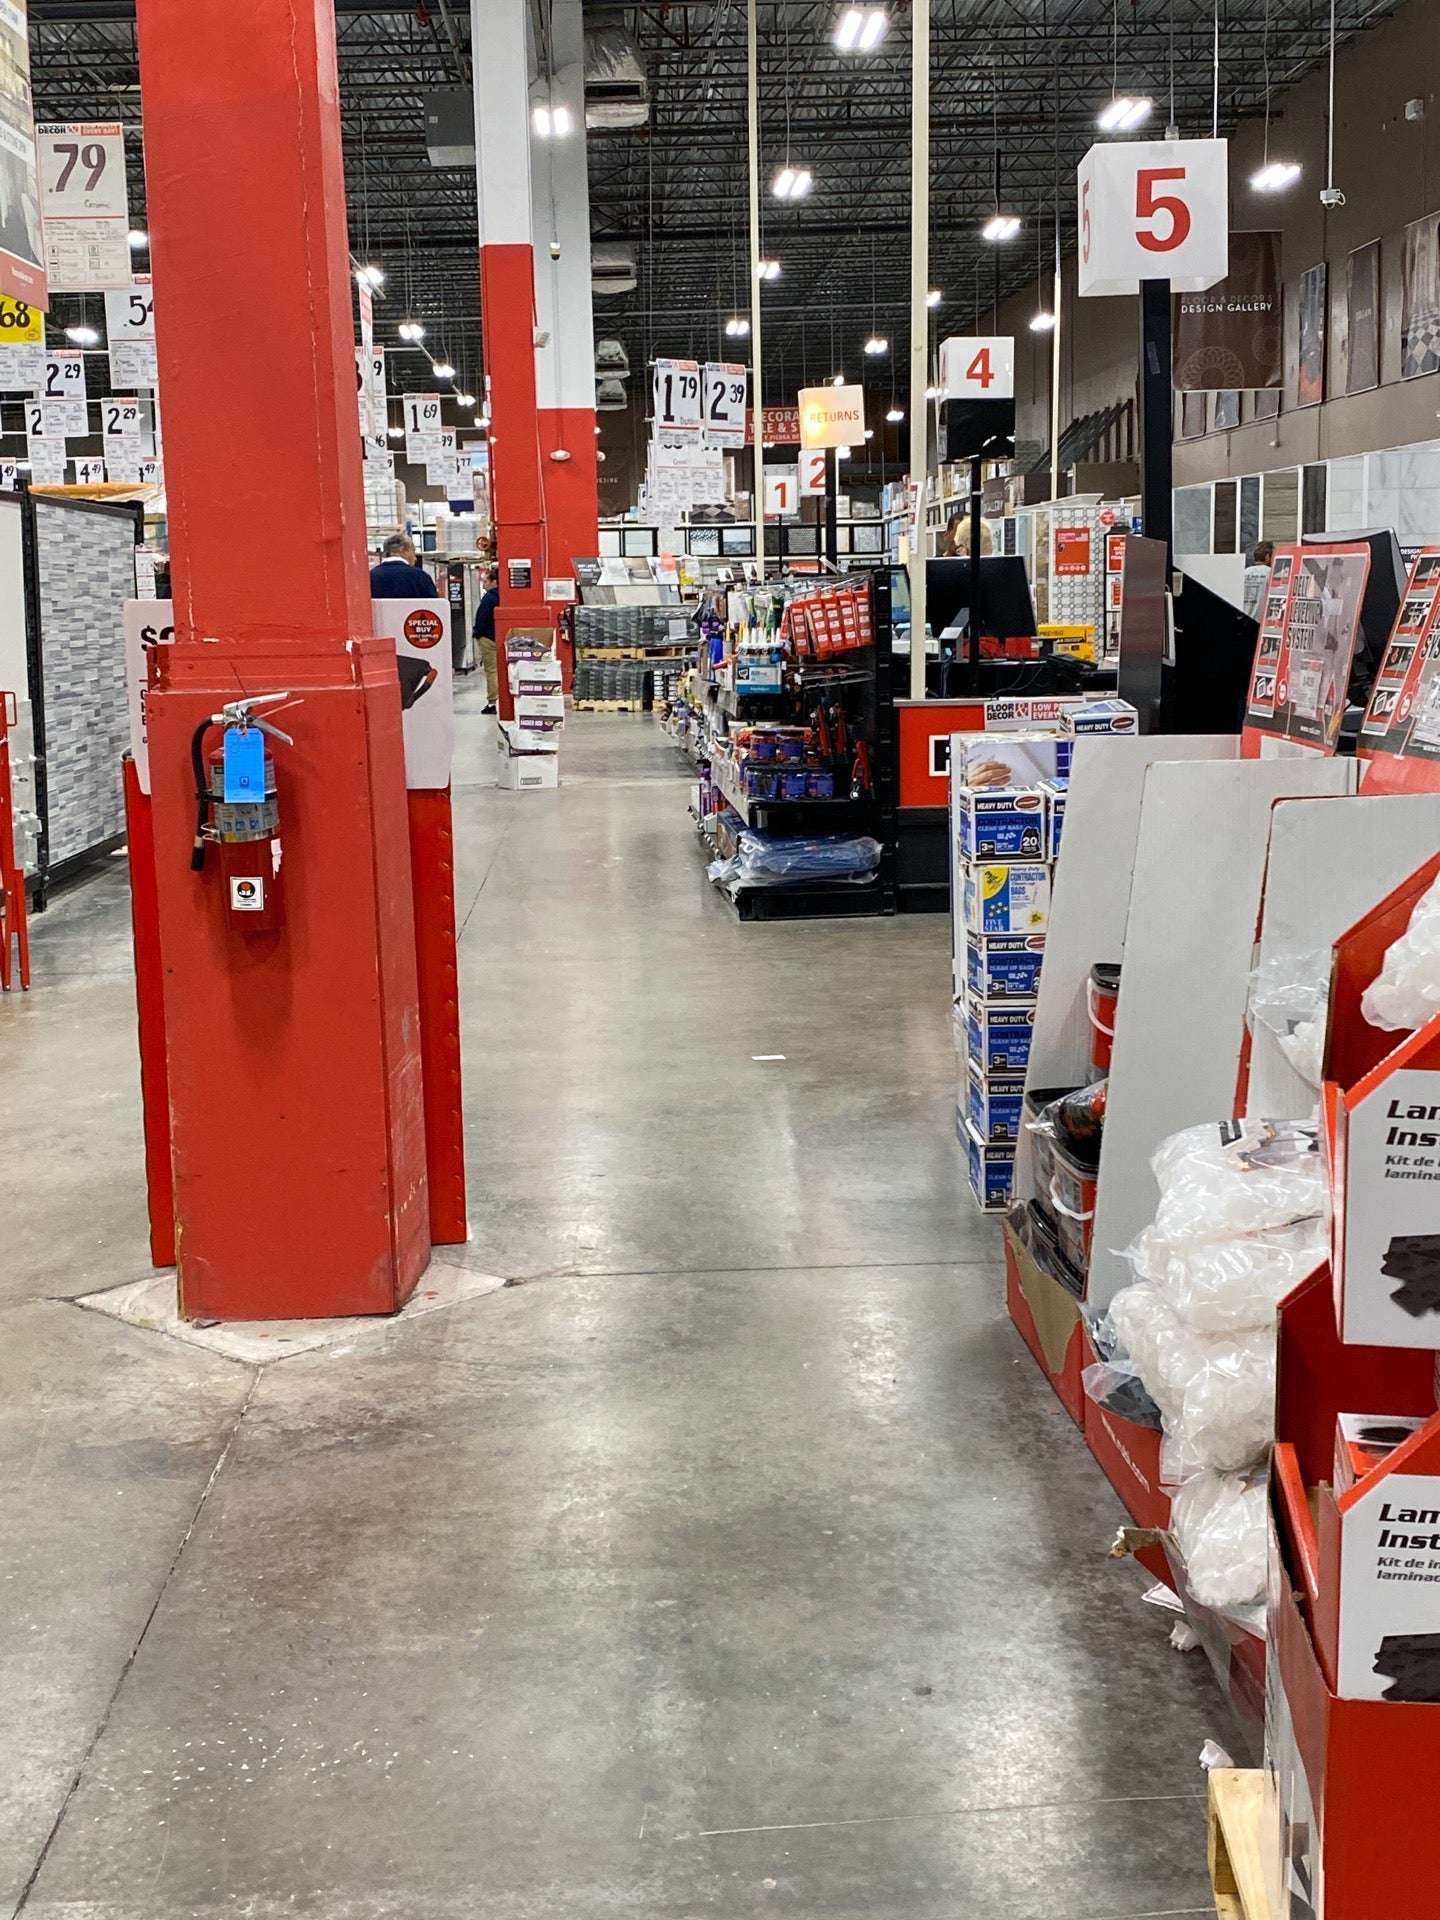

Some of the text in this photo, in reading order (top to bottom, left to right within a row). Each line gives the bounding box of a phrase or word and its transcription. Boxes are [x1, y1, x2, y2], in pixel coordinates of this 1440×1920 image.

[1135, 167, 1191, 253] 5
[1181, 302, 1273, 314] DESIGN GALLERY
[966, 348, 995, 389] 4
[809, 410, 860, 424] RETURNS
[749, 422, 774, 434] TLE
[777, 422, 787, 433] &
[809, 456, 826, 489] 2
[774, 482, 787, 509] 1
[408, 619, 439, 627] SPECIAL
[1286, 627, 1315, 651] SYSTEM
[986, 703, 1014, 712] FLOOR
[1032, 703, 1052, 712] LOW
[986, 711, 1060, 721] DECOR EVERY
[1076, 723, 1109, 732] HEAVY DUTY
[977, 801, 1013, 810] HEAVY DUTY
[1022, 836, 1038, 847] 20
[1010, 872, 1047, 882] CONTRACTOR
[1010, 886, 1026, 896] BAGS
[985, 918, 1003, 926] FIVE
[988, 941, 1024, 950] HEAVY DUTY
[989, 1015, 1026, 1024] HEAVY DUTY
[990, 1085, 1009, 1093] HEAVY
[1386, 1126, 1440, 1147] Ins
[986, 1151, 1005, 1159] HEAVY
[1385, 1155, 1411, 1166] Kit
[1413, 1156, 1435, 1167] de
[1377, 1529, 1440, 1551] Inst
[1377, 1556, 1402, 1568] Kit
[1404, 1558, 1426, 1569] de
